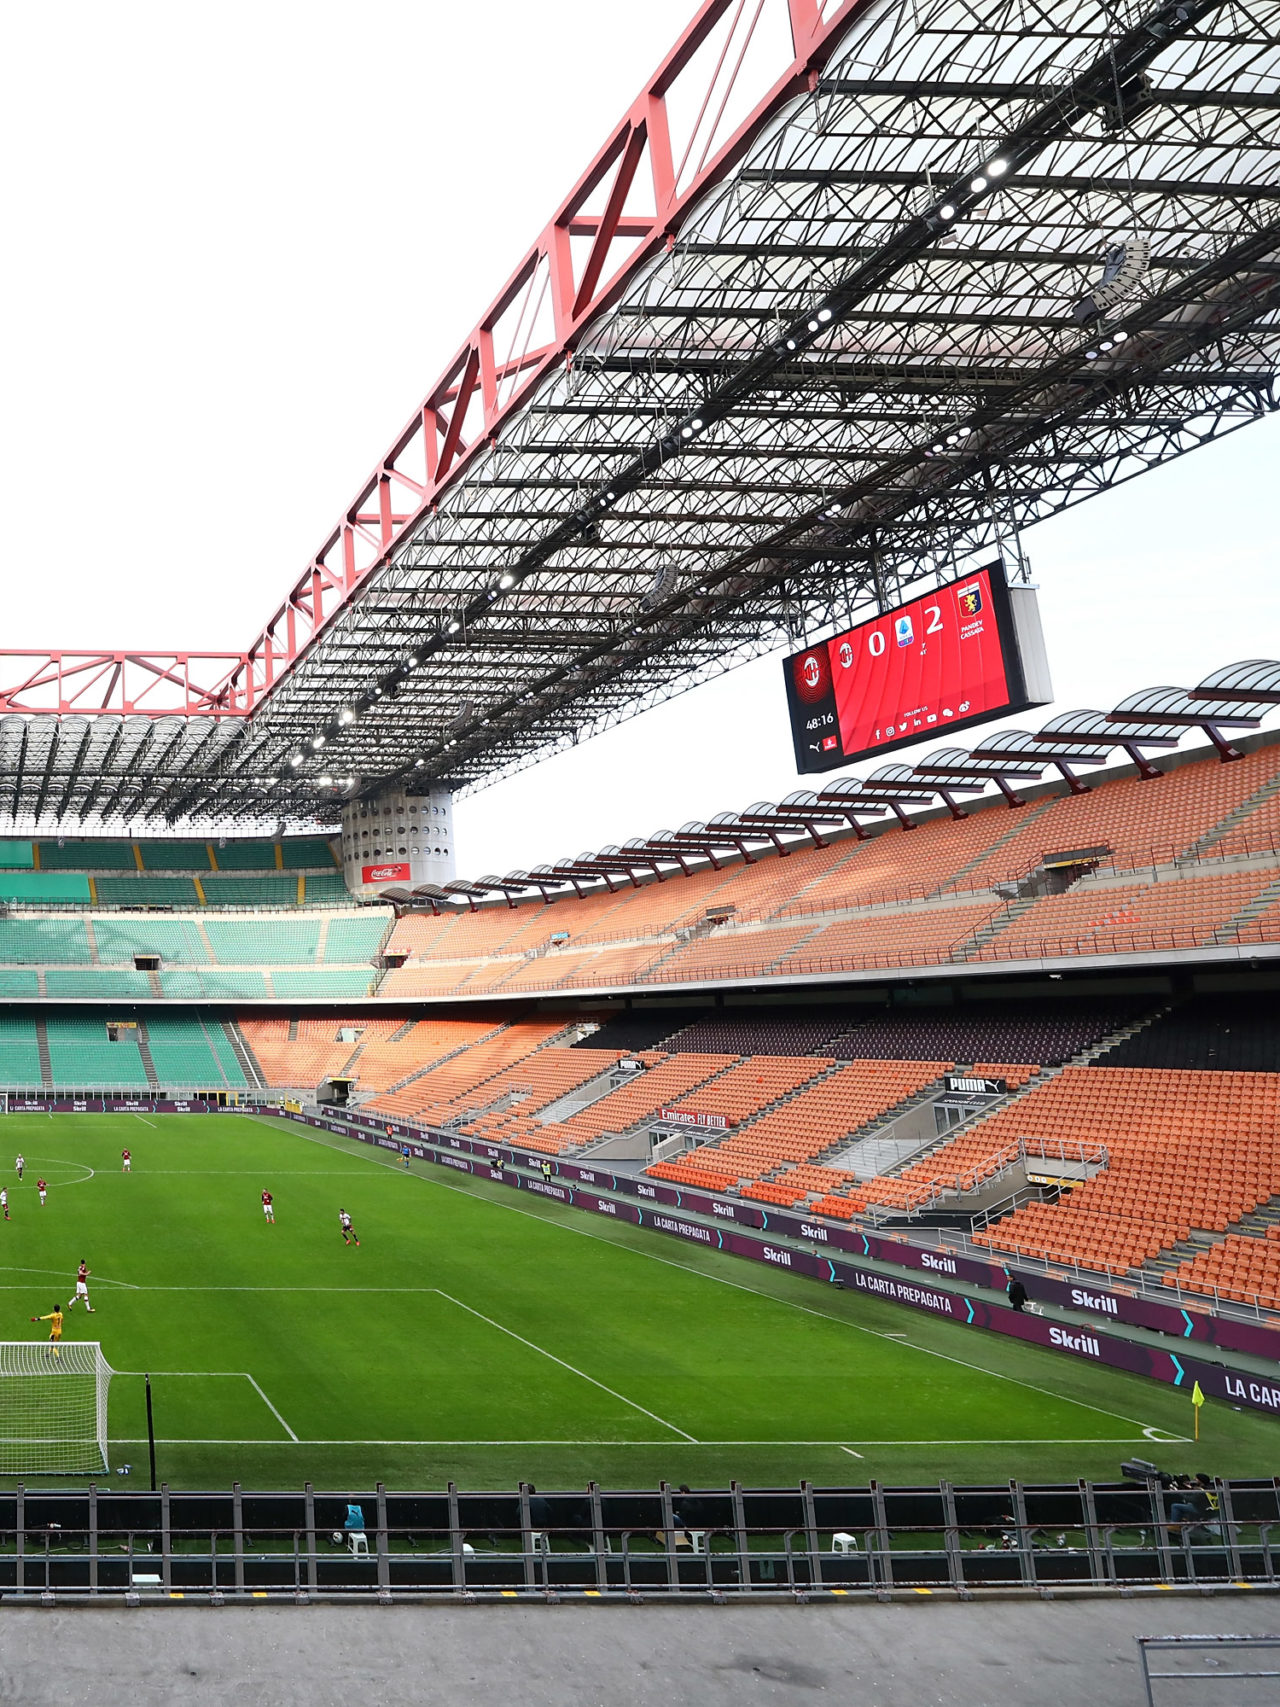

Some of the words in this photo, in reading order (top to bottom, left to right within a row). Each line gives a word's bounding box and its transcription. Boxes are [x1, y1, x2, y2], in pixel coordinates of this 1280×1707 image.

[868, 632, 885, 656] 0
[924, 606, 943, 634] 2
[806, 712, 834, 730] 48:16
[950, 1078, 986, 1092] PUMA
[662, 1109, 695, 1124] Emirates
[707, 1115, 726, 1127] BETTER
[580, 1170, 594, 1182] Skrill
[638, 1185, 655, 1197] Skrill
[598, 1200, 616, 1214] Skrill
[713, 1203, 734, 1217] Skrill
[654, 1216, 661, 1226] LA
[661, 1218, 678, 1230] CARTA
[678, 1223, 710, 1242] PREPAGATA
[801, 1224, 828, 1241] Skrill
[763, 1247, 791, 1266] Skrill
[921, 1254, 956, 1274] Skrill
[855, 1273, 867, 1287] LA
[868, 1276, 896, 1297] CARTA
[898, 1284, 952, 1313] PREPAGATA
[1071, 1289, 1118, 1314] Skrill
[1049, 1327, 1100, 1356] Skrill
[1225, 1376, 1247, 1399] LA
